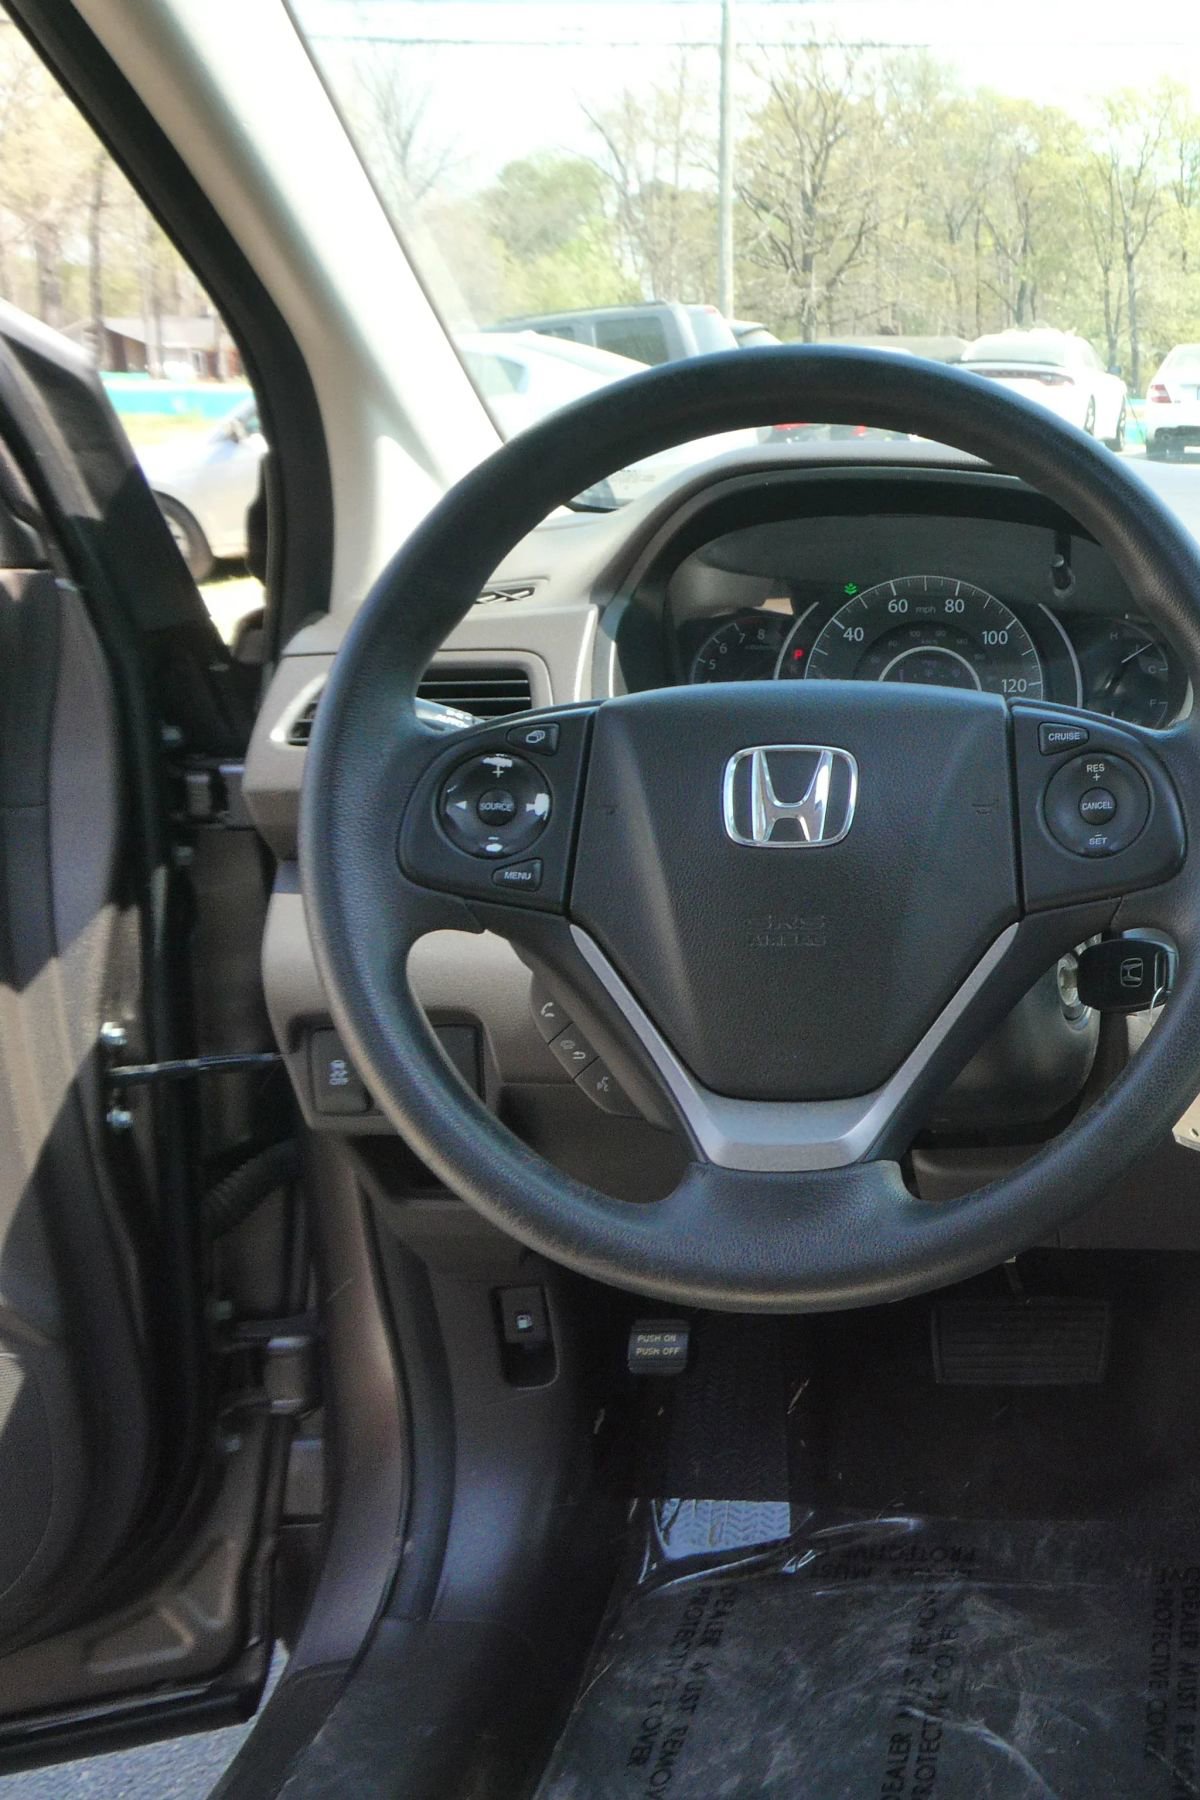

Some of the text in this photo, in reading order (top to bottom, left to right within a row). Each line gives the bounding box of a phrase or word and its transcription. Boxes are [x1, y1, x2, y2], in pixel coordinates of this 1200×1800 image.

[887, 598, 909, 614] 60
[944, 599, 965, 614] 80
[739, 632, 746, 644] 7
[757, 628, 766, 641] 8
[842, 626, 865, 643] 40
[981, 630, 1009, 646] 100
[719, 643, 728, 655] 6
[708, 658, 717, 671] 5
[1001, 678, 1028, 694] 120
[1047, 731, 1081, 742] CRUISE
[1086, 763, 1105, 774] RES
[479, 802, 513, 812] SOURCE
[1081, 800, 1113, 811] CANCEL
[1089, 836, 1108, 846] SET
[504, 871, 532, 881] MENU
[637, 1334, 677, 1343] PUSH ON
[635, 1346, 681, 1356] PUSH OFF
[1179, 1585, 1200, 1650] DEALER
[1149, 1588, 1174, 1690] PROTECTIVE
[1176, 1660, 1198, 1713] MUST
